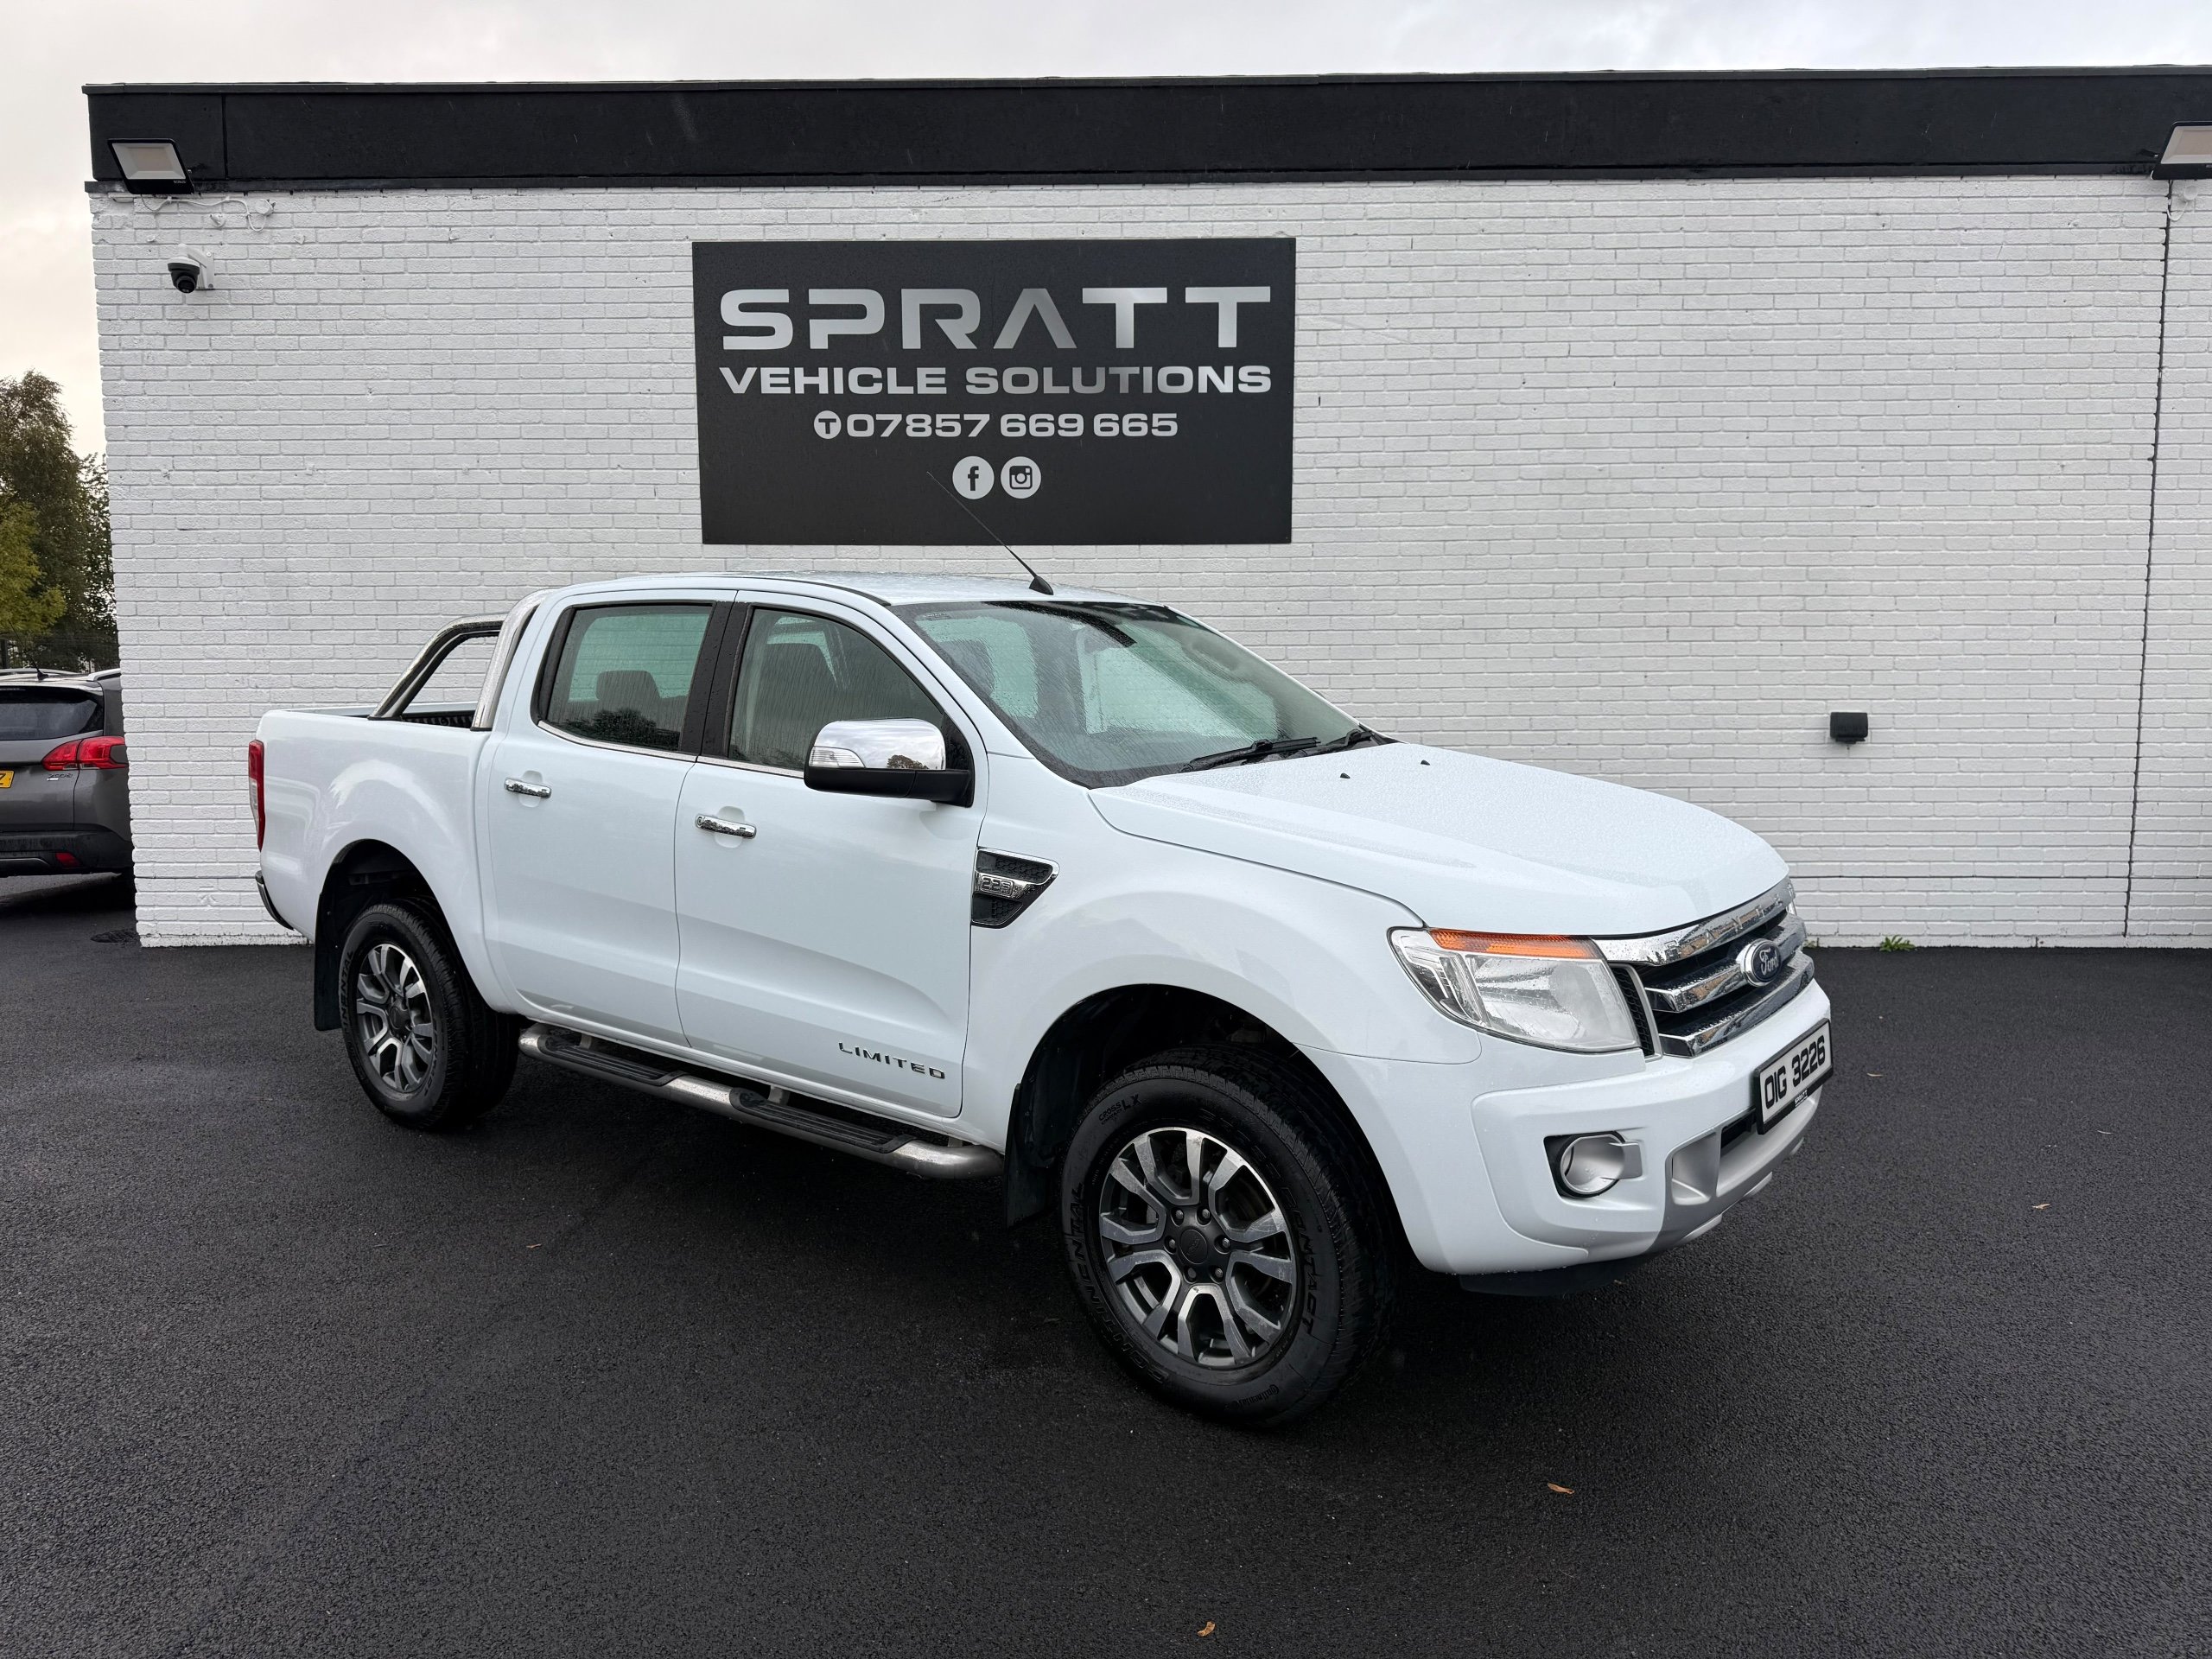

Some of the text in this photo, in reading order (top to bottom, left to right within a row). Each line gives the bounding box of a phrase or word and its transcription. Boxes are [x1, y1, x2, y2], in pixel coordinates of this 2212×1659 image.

[720, 286, 1271, 350] SPRATT
[719, 365, 1272, 395] VEHICLE SOLUTIONS
[846, 413, 990, 438] 07857
[1000, 413, 1084, 437] 669
[1093, 412, 1179, 437] 665
[1758, 949, 1778, 976] Ford
[838, 1041, 946, 1079] LIMITED
[1764, 1034, 1826, 1109] OIG 3226
[1070, 1181, 1169, 1385] CONTINENTAL
